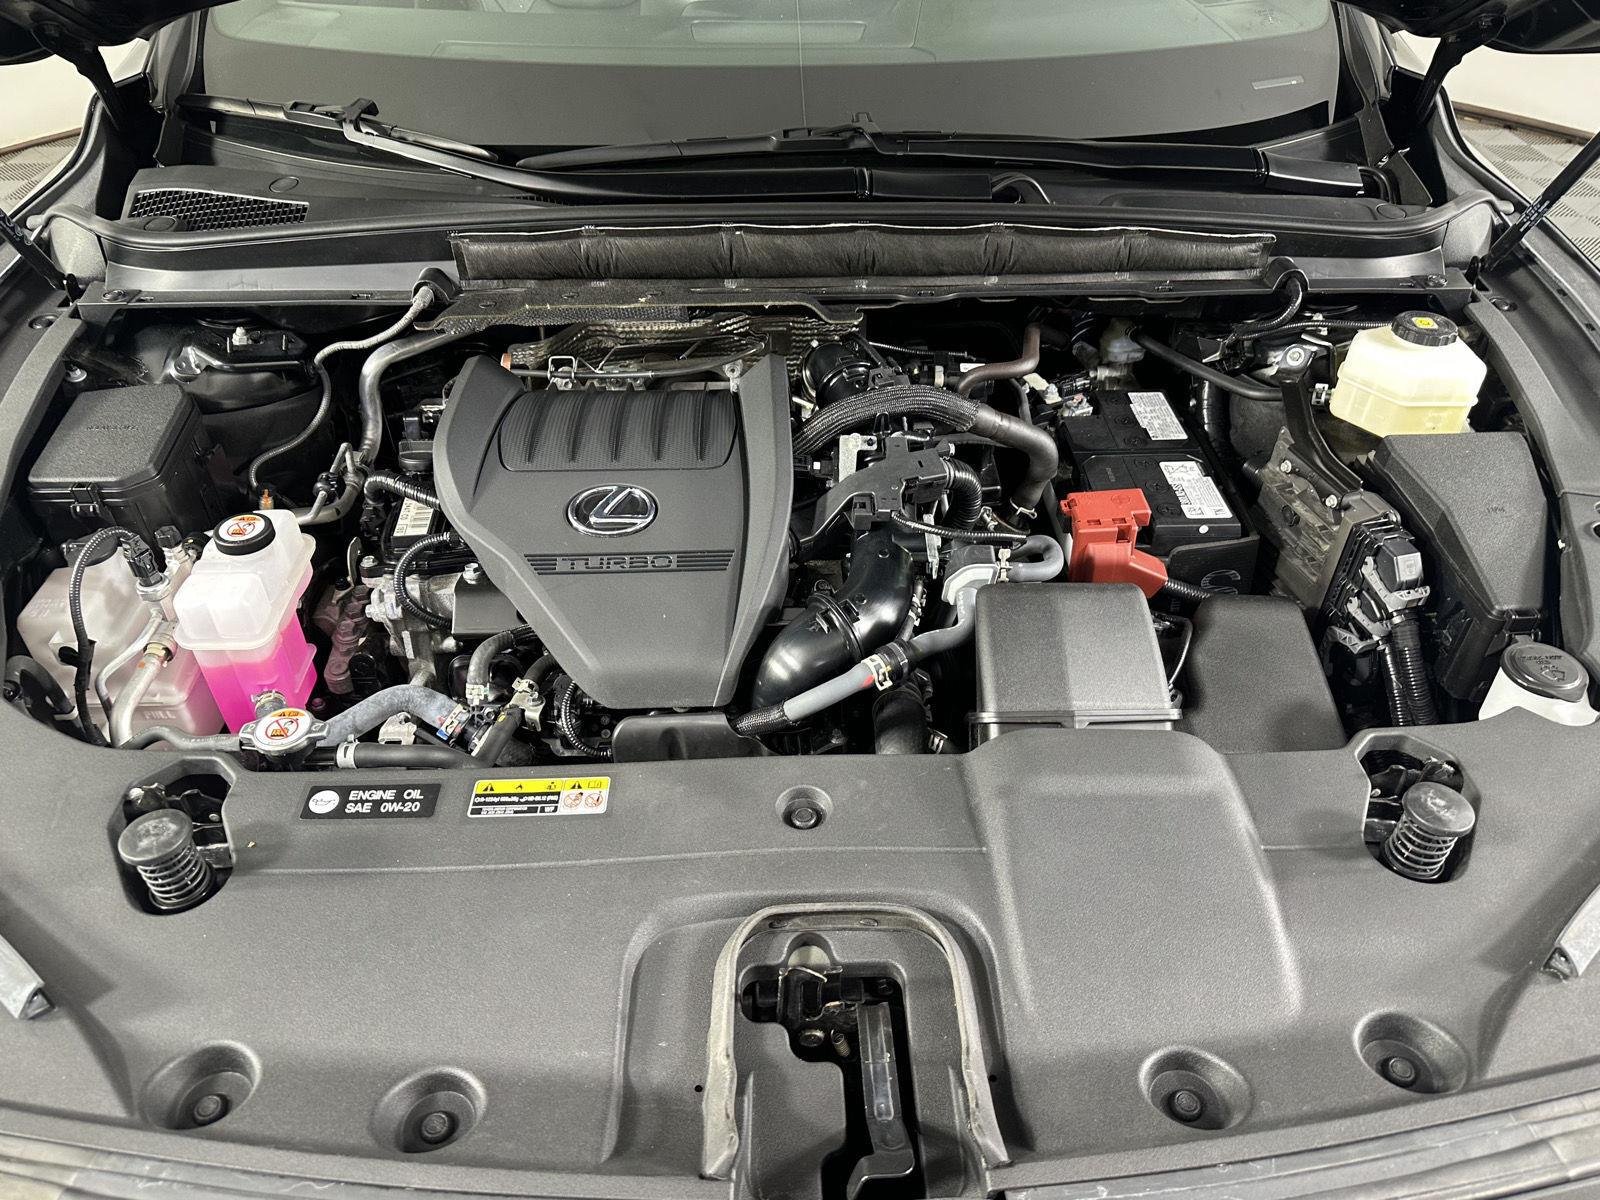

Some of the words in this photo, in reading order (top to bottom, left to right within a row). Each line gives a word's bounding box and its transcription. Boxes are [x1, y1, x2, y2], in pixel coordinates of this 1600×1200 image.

[560, 555, 673, 571] TURBO
[348, 789, 397, 801] ENGINE
[403, 789, 424, 800] OIL
[344, 802, 373, 814] SAE
[380, 801, 421, 813] 0W-20
